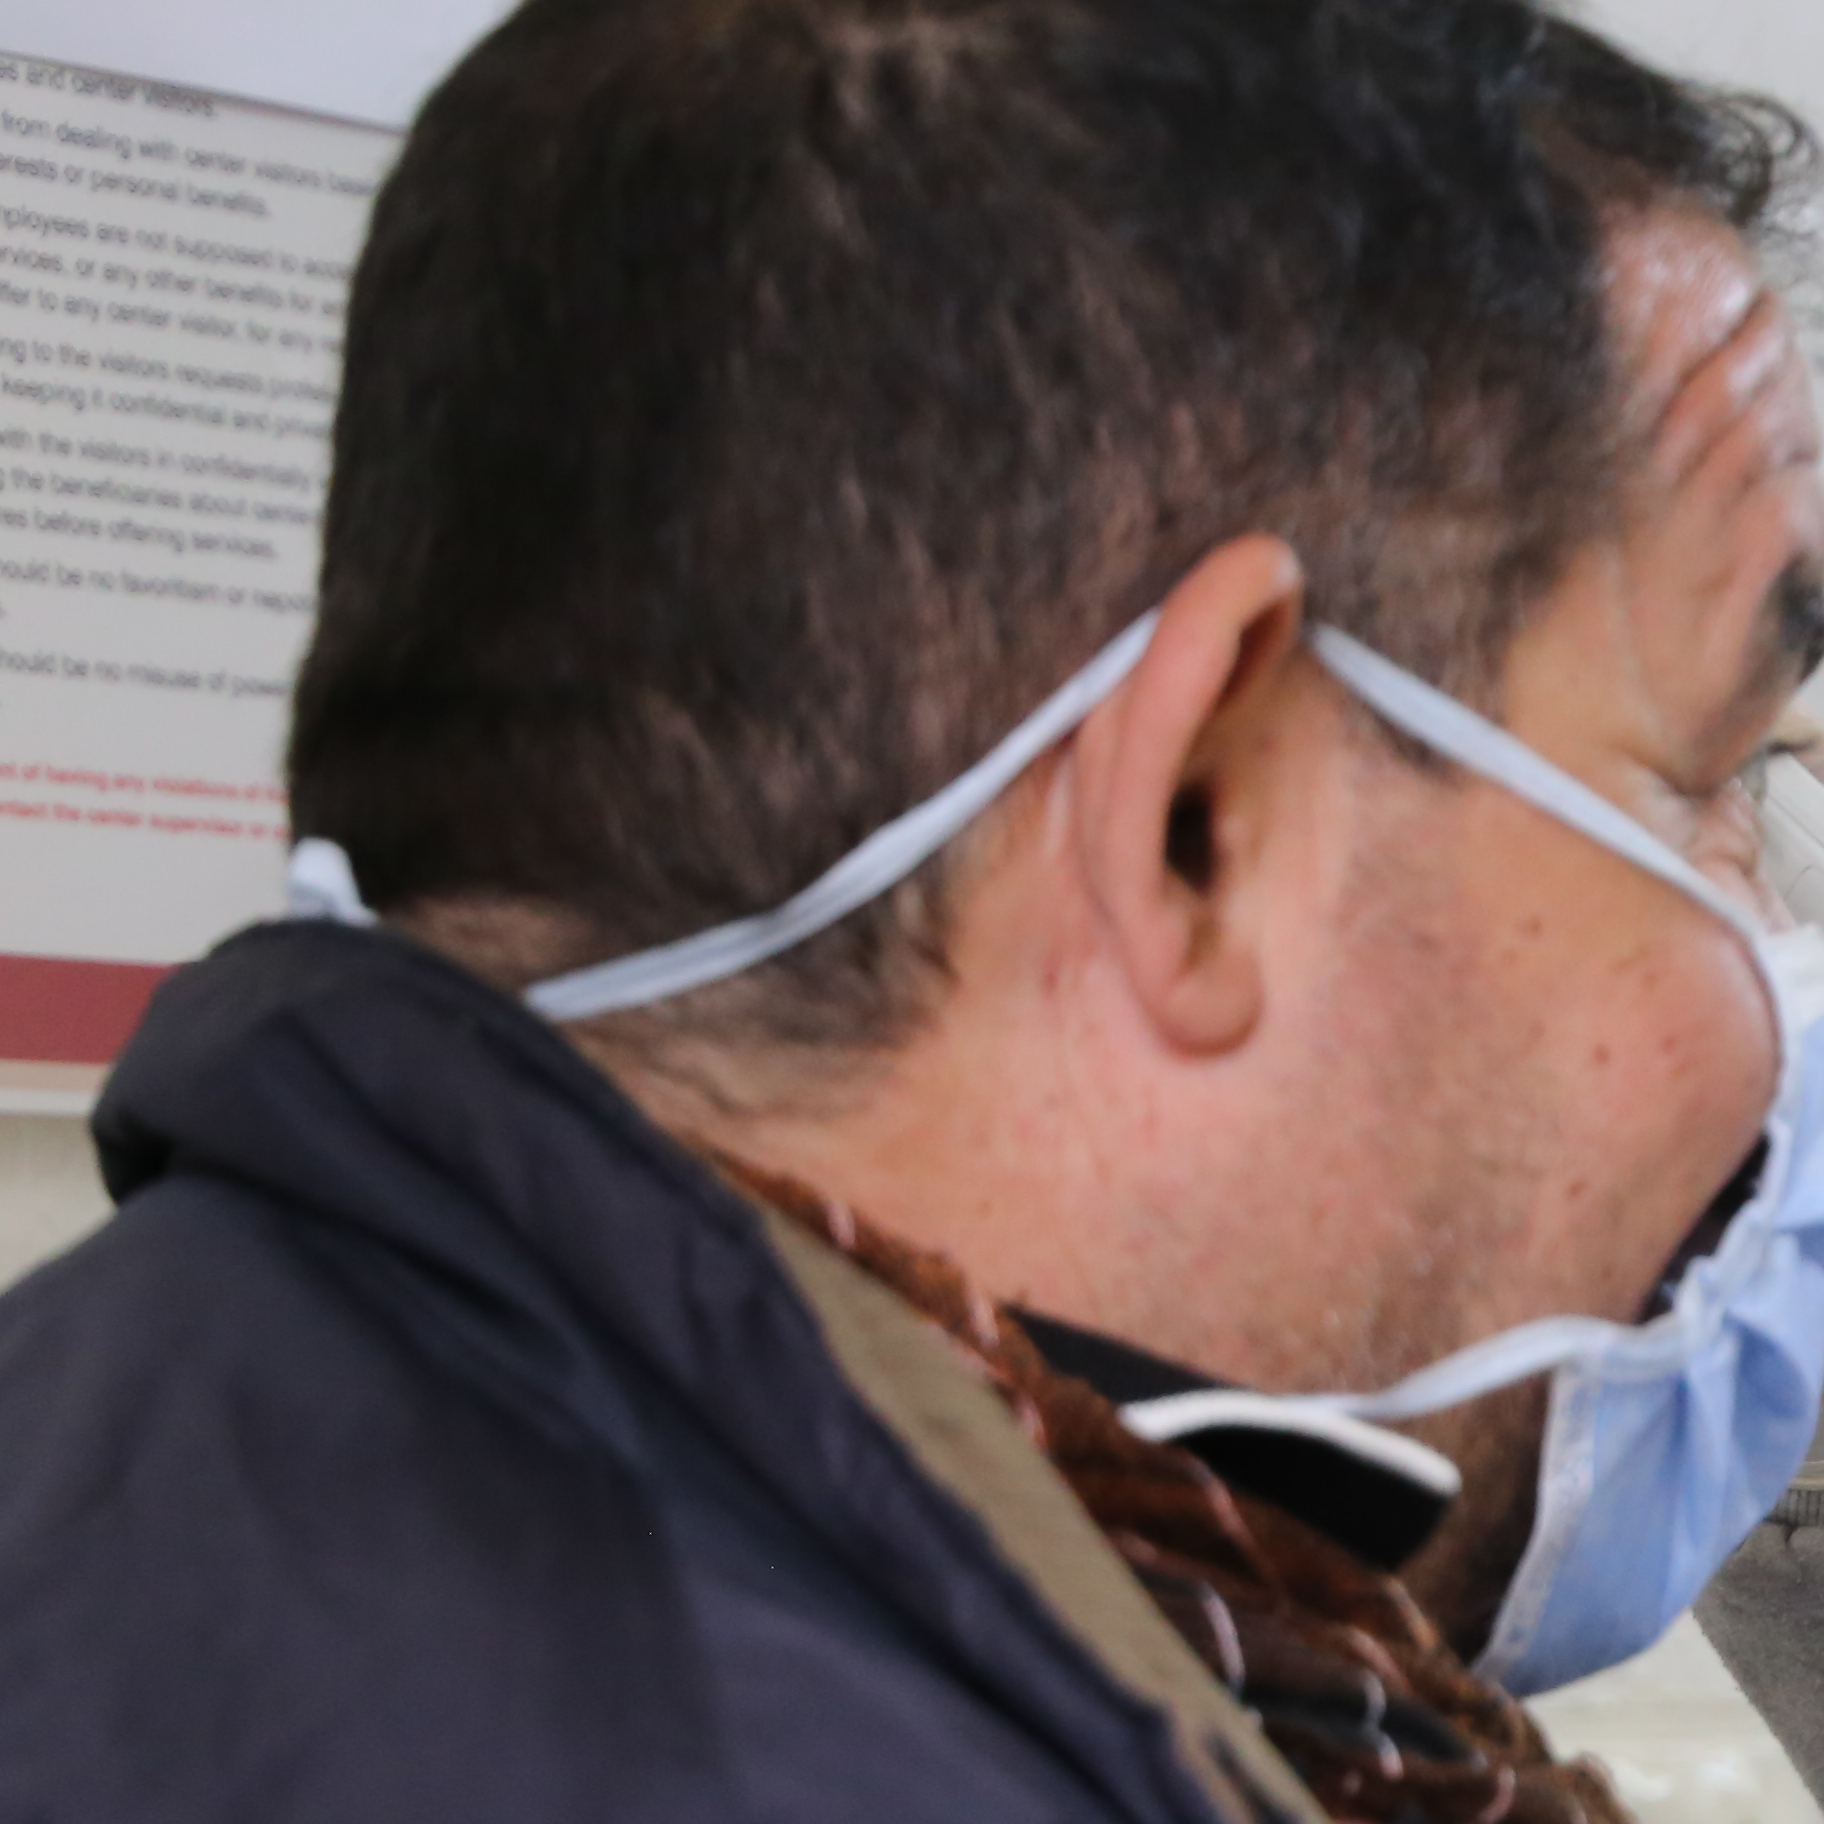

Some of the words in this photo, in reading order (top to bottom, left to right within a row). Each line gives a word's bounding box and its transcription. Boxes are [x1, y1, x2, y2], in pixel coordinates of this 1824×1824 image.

[2, 109, 48, 139] from
[56, 122, 131, 161] dealing
[139, 140, 178, 163] with
[64, 164, 84, 186] or
[90, 170, 178, 204] personal
[97, 223, 129, 246] are
[136, 229, 168, 254] not
[174, 235, 272, 271] supposed
[104, 262, 137, 290] any
[65, 295, 99, 323] any
[108, 302, 170, 330] center
[33, 340, 53, 366] to
[60, 343, 90, 370] the
[2, 376, 85, 414] keeping
[57, 564, 83, 588] be
[63, 656, 89, 680] be
